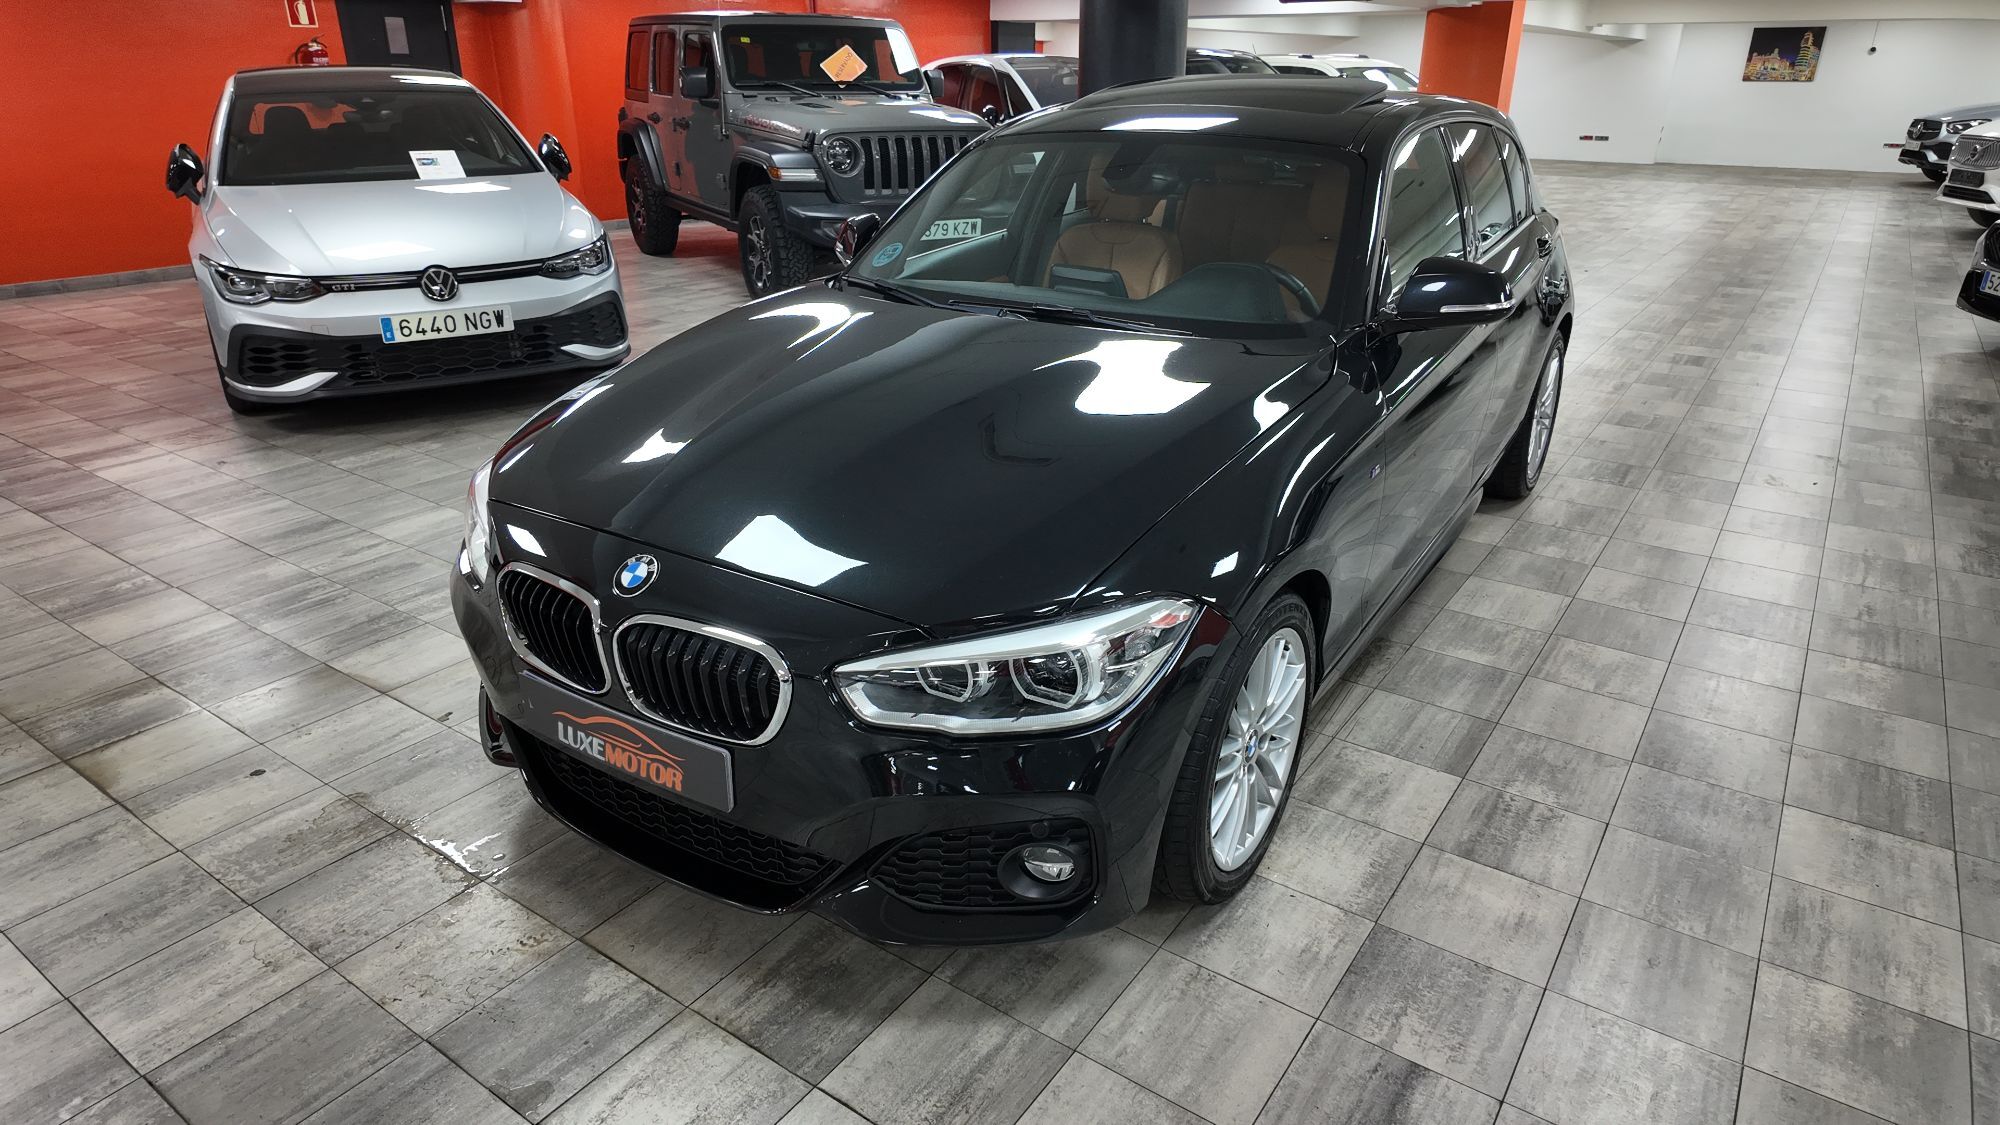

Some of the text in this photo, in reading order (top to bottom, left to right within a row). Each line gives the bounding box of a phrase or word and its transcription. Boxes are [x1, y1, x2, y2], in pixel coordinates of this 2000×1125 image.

[953, 221, 978, 236] KZW
[331, 283, 356, 292] GTI
[399, 309, 505, 338] 6440 NGW
[627, 556, 656, 572] BMW
[557, 721, 683, 792] LUXEMOTOR
